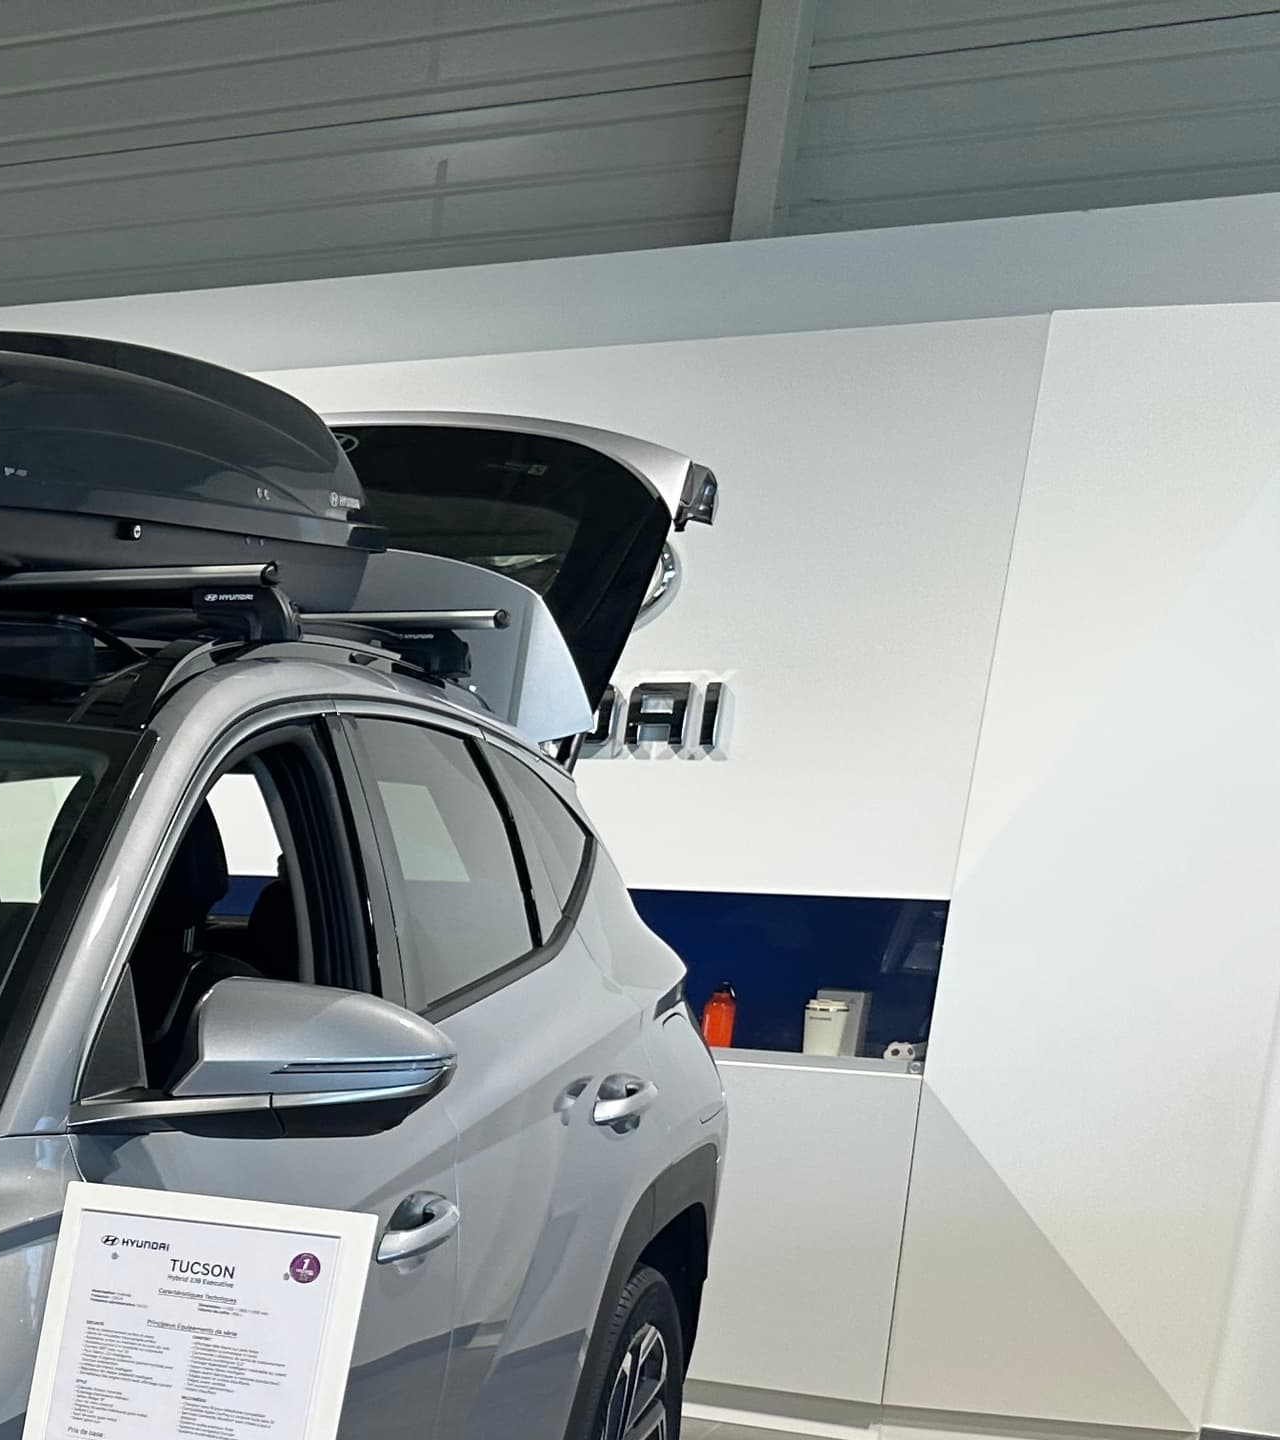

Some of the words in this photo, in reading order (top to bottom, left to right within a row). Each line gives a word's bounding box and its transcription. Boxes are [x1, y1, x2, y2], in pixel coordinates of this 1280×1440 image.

[121, 1238, 169, 1251] HYUNDAI
[168, 1258, 235, 1278] TUCSON
[167, 1274, 188, 1283] Hybrid
[202, 1278, 234, 1288] Executive
[88, 1429, 103, 1437] base
